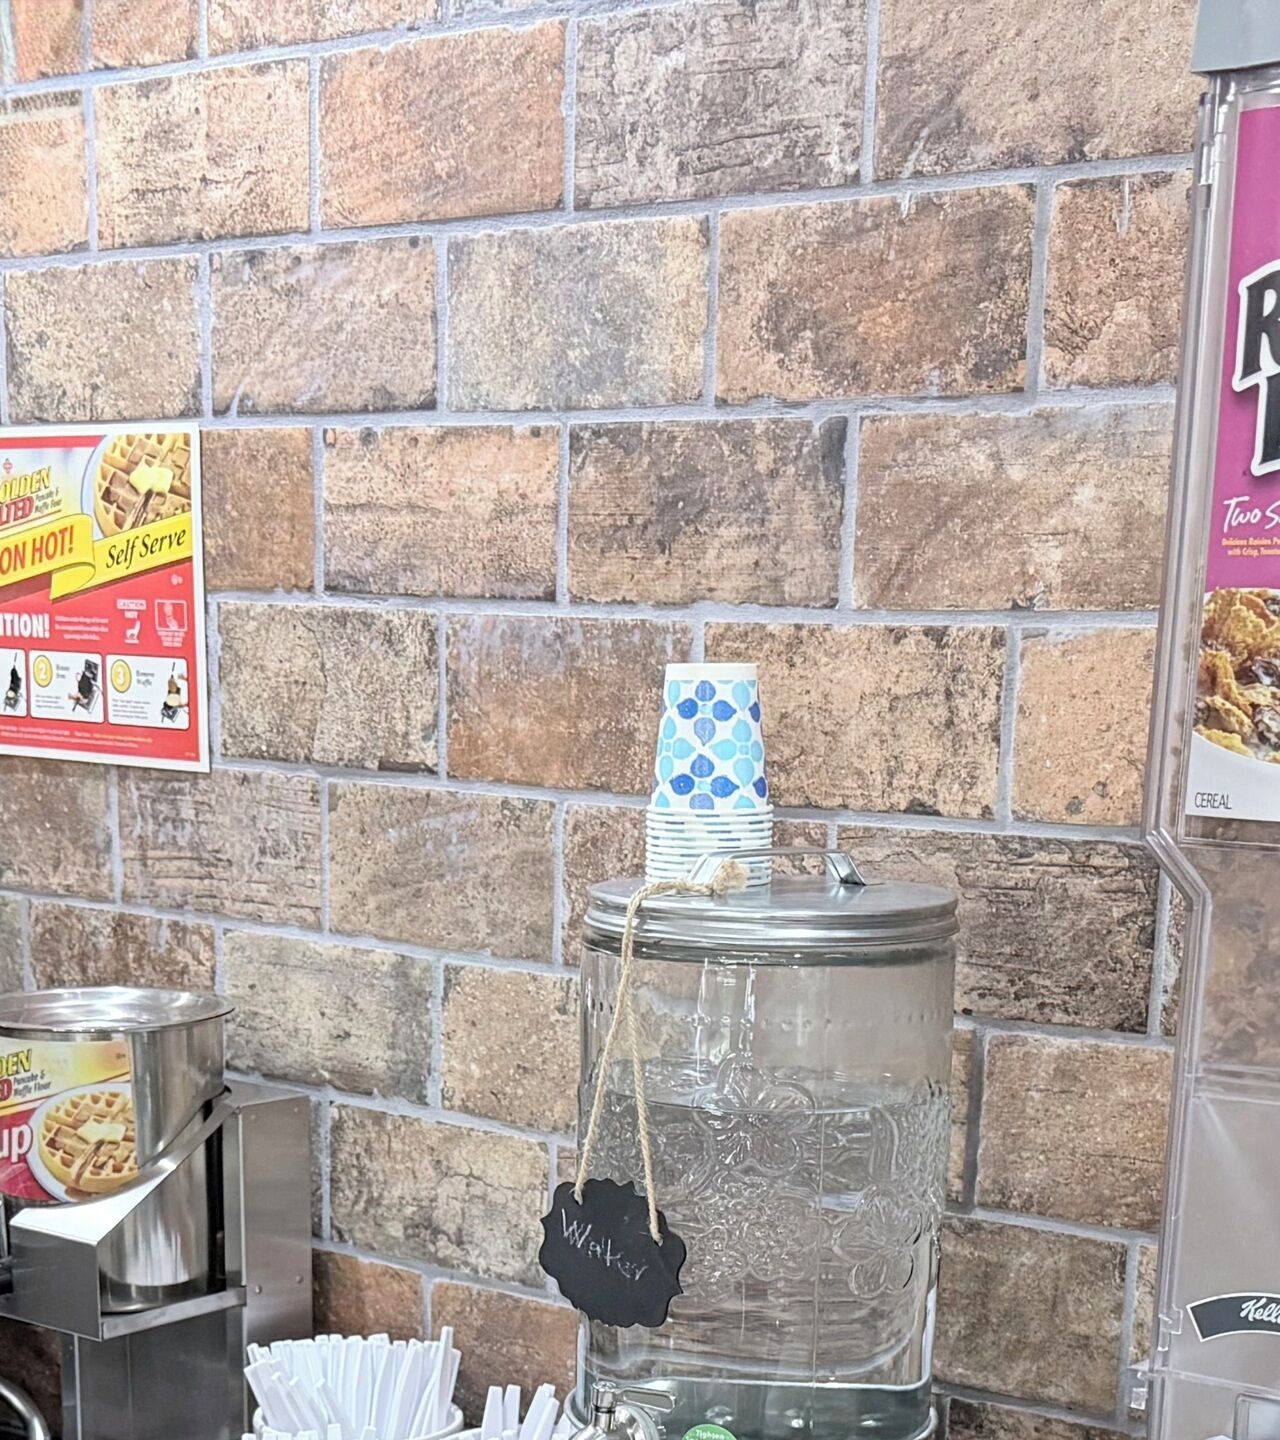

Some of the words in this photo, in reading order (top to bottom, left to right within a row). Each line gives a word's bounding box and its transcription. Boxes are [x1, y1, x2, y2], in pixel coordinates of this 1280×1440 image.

[1222, 495, 1262, 533] Two
[31, 524, 75, 563] HOT!
[105, 538, 138, 570] Self
[139, 527, 187, 560] Serve
[1194, 792, 1233, 811] CEREAL
[695, 1429, 726, 1440] Tighten
